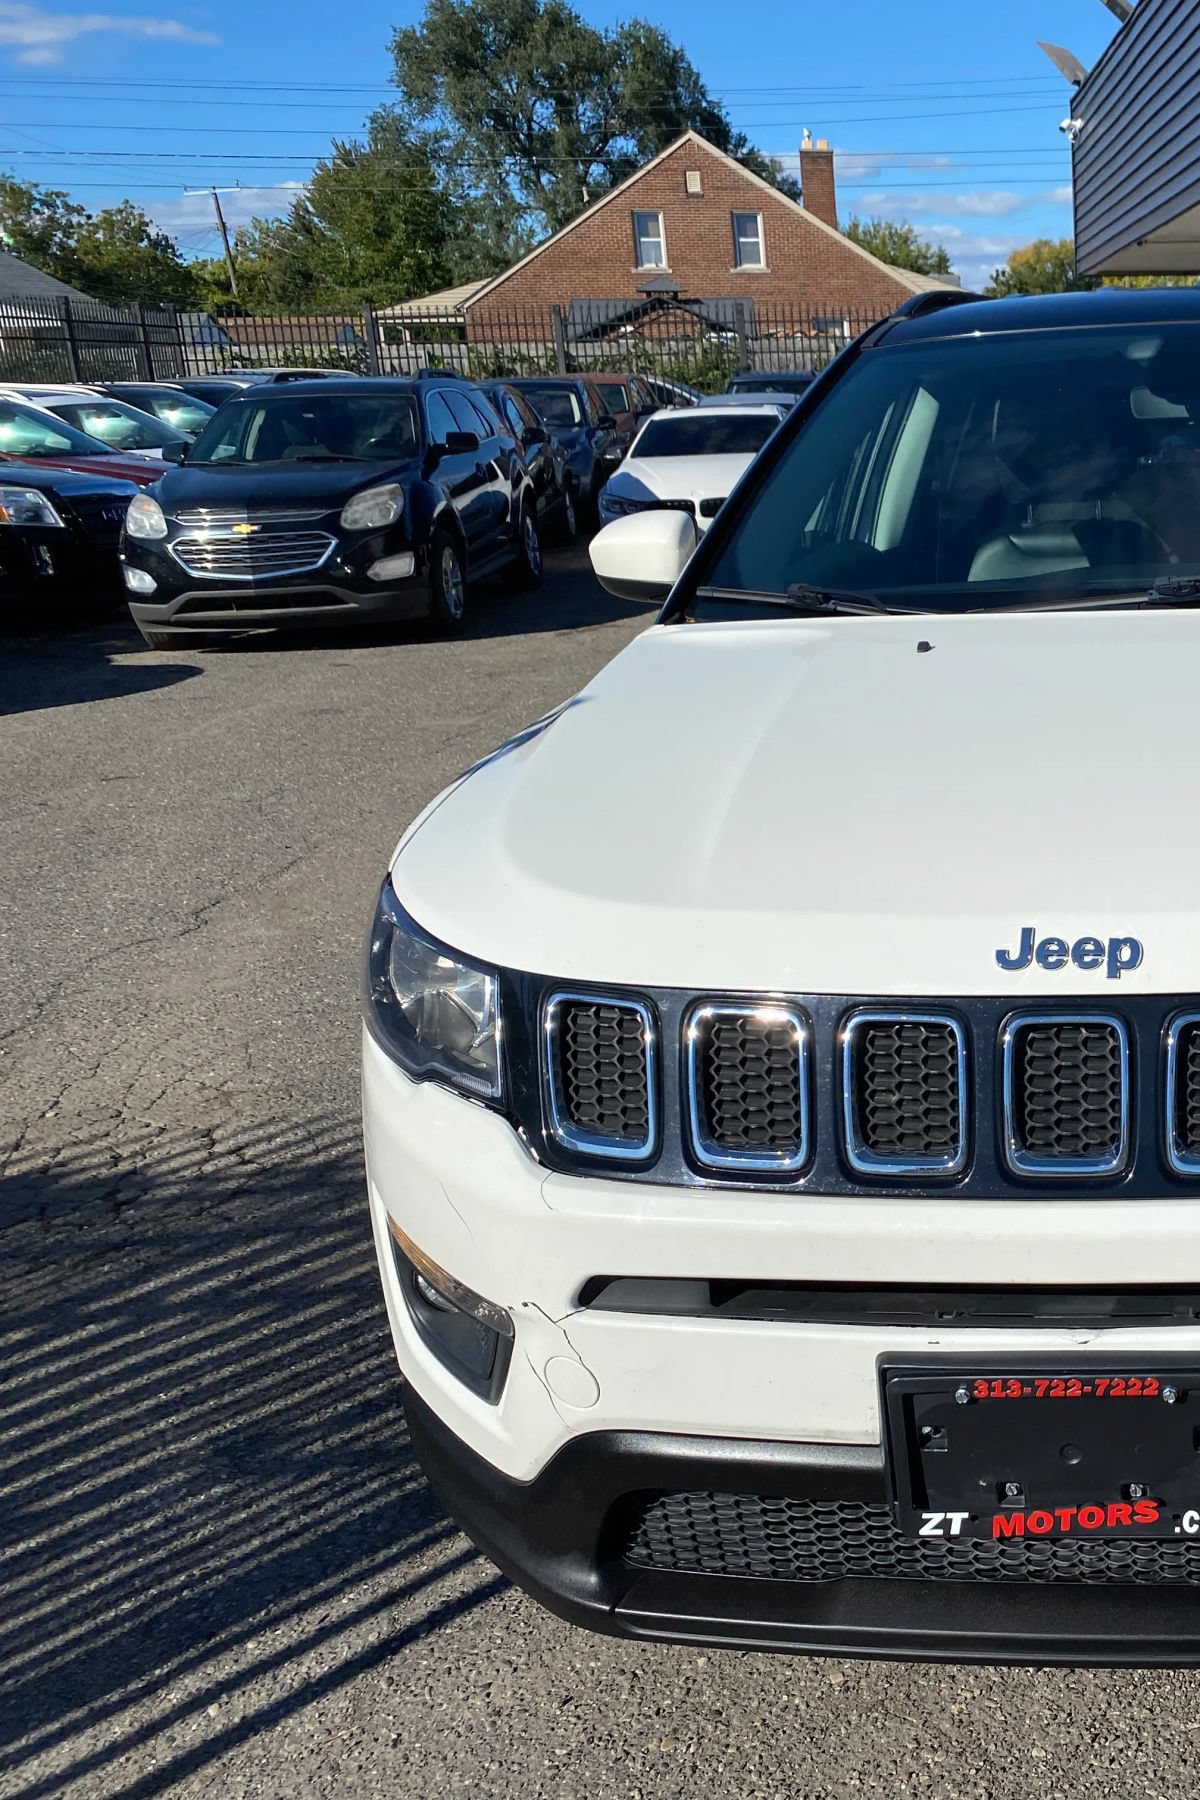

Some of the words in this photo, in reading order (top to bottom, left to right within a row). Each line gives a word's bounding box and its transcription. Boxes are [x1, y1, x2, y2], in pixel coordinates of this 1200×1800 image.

[995, 927, 1144, 980] Jeep
[973, 1377, 1161, 1399] 313-722-7222
[918, 1511, 970, 1537] ZT
[992, 1499, 1161, 1539] MOTORS
